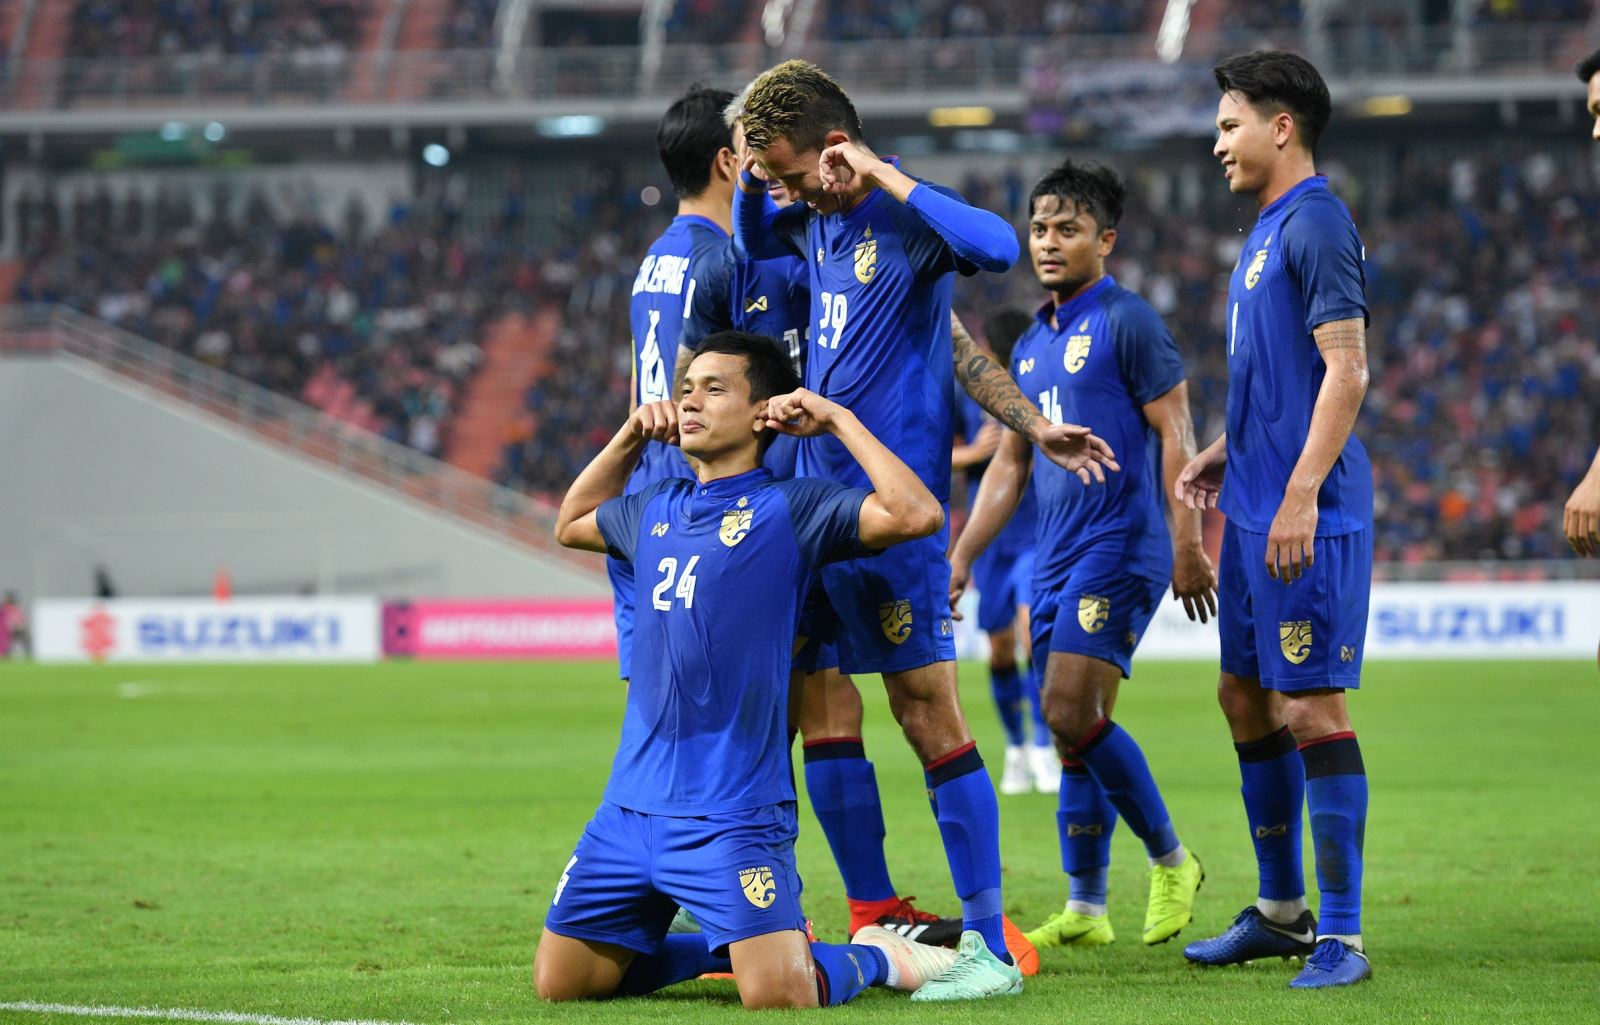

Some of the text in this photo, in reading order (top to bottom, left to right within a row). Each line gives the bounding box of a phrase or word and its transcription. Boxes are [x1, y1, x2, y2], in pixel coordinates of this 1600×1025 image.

[818, 291, 848, 349] 29
[652, 555, 700, 611] 24
[137, 613, 341, 649] SUZUKI
[1375, 604, 1566, 642] SUZUKI
